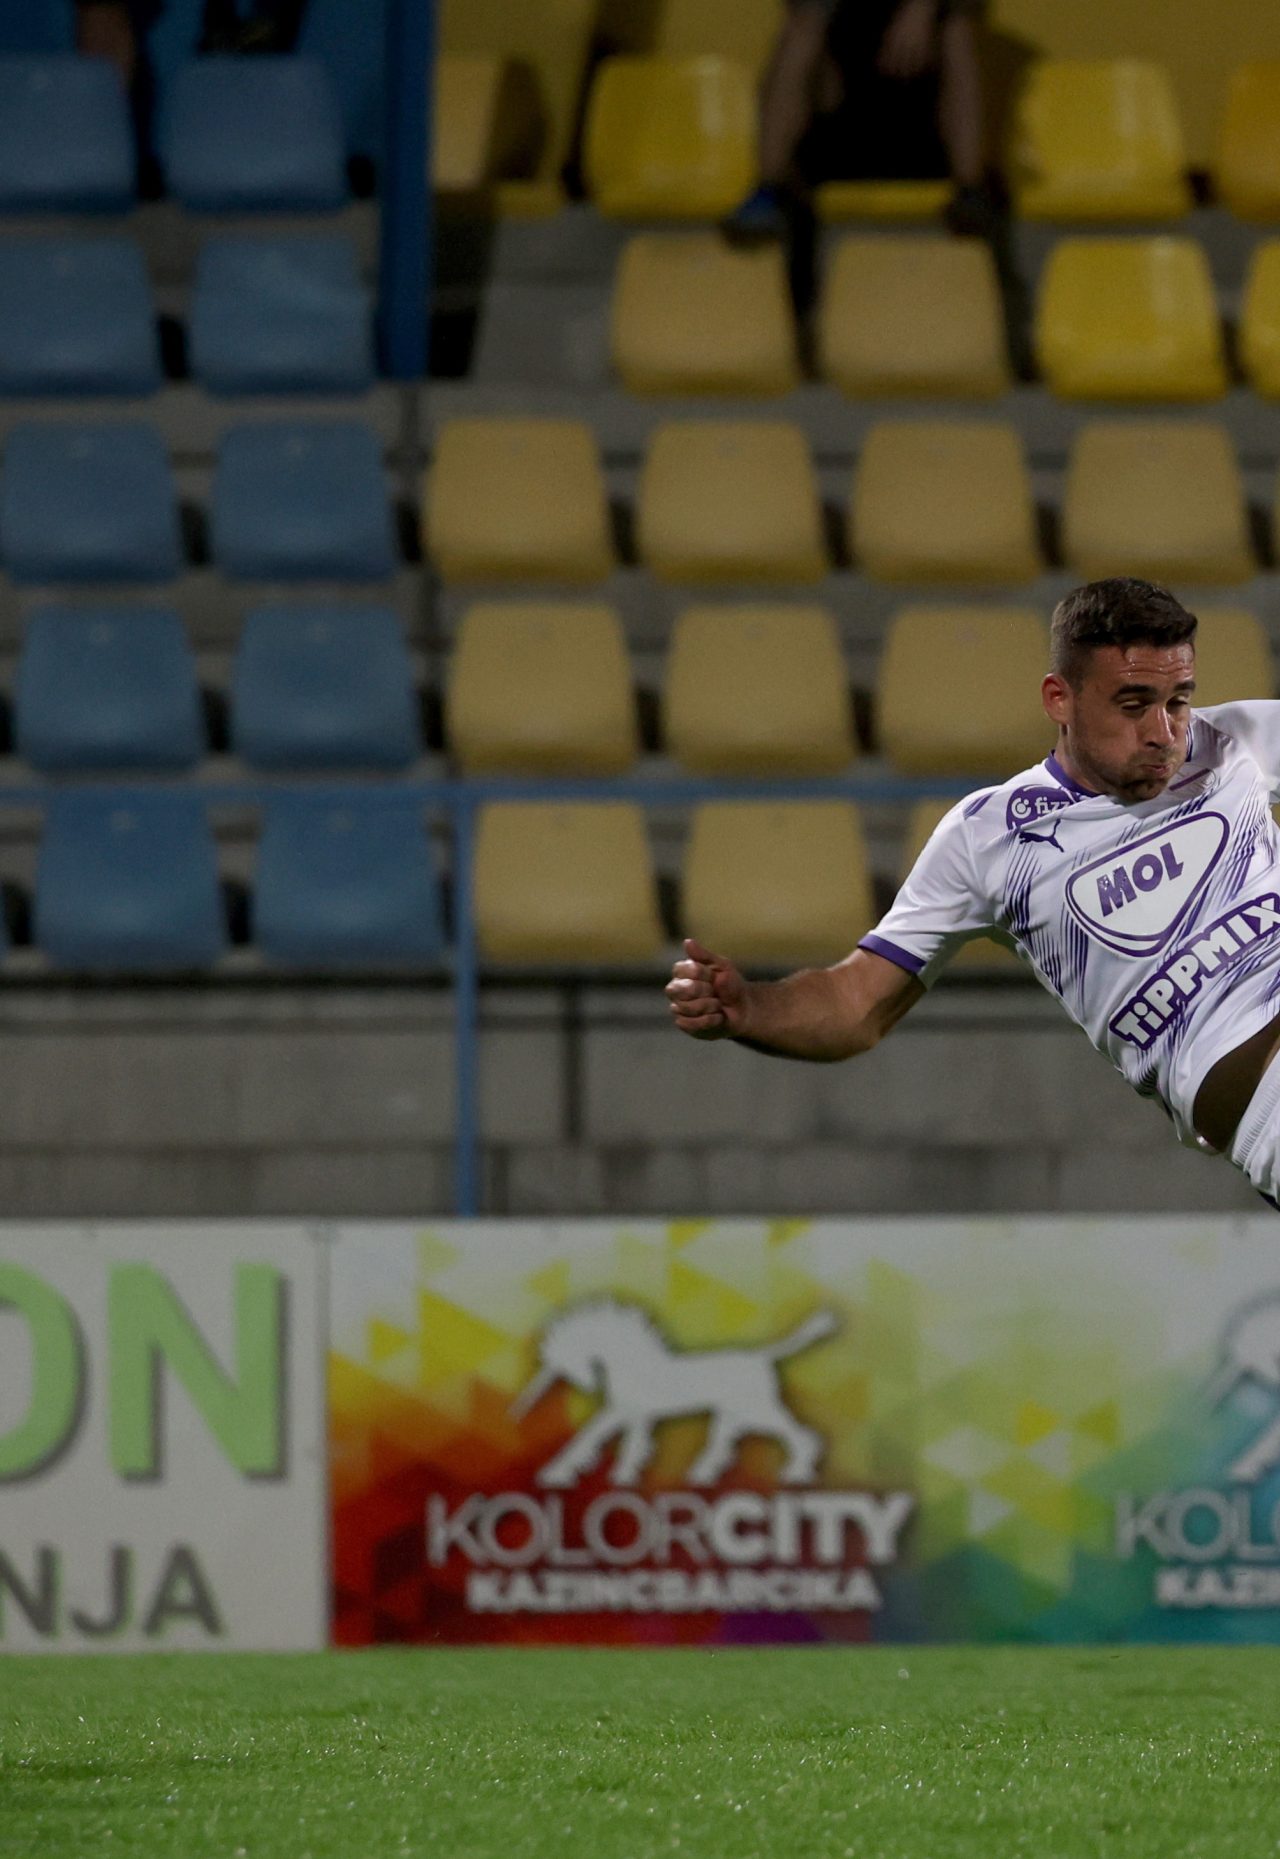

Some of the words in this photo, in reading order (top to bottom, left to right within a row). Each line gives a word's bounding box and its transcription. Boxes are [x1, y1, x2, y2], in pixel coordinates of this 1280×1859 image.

[1096, 842, 1184, 917] MOL
[427, 1491, 911, 1566] KOLORCITY
[0, 1544, 223, 1639] NJA
